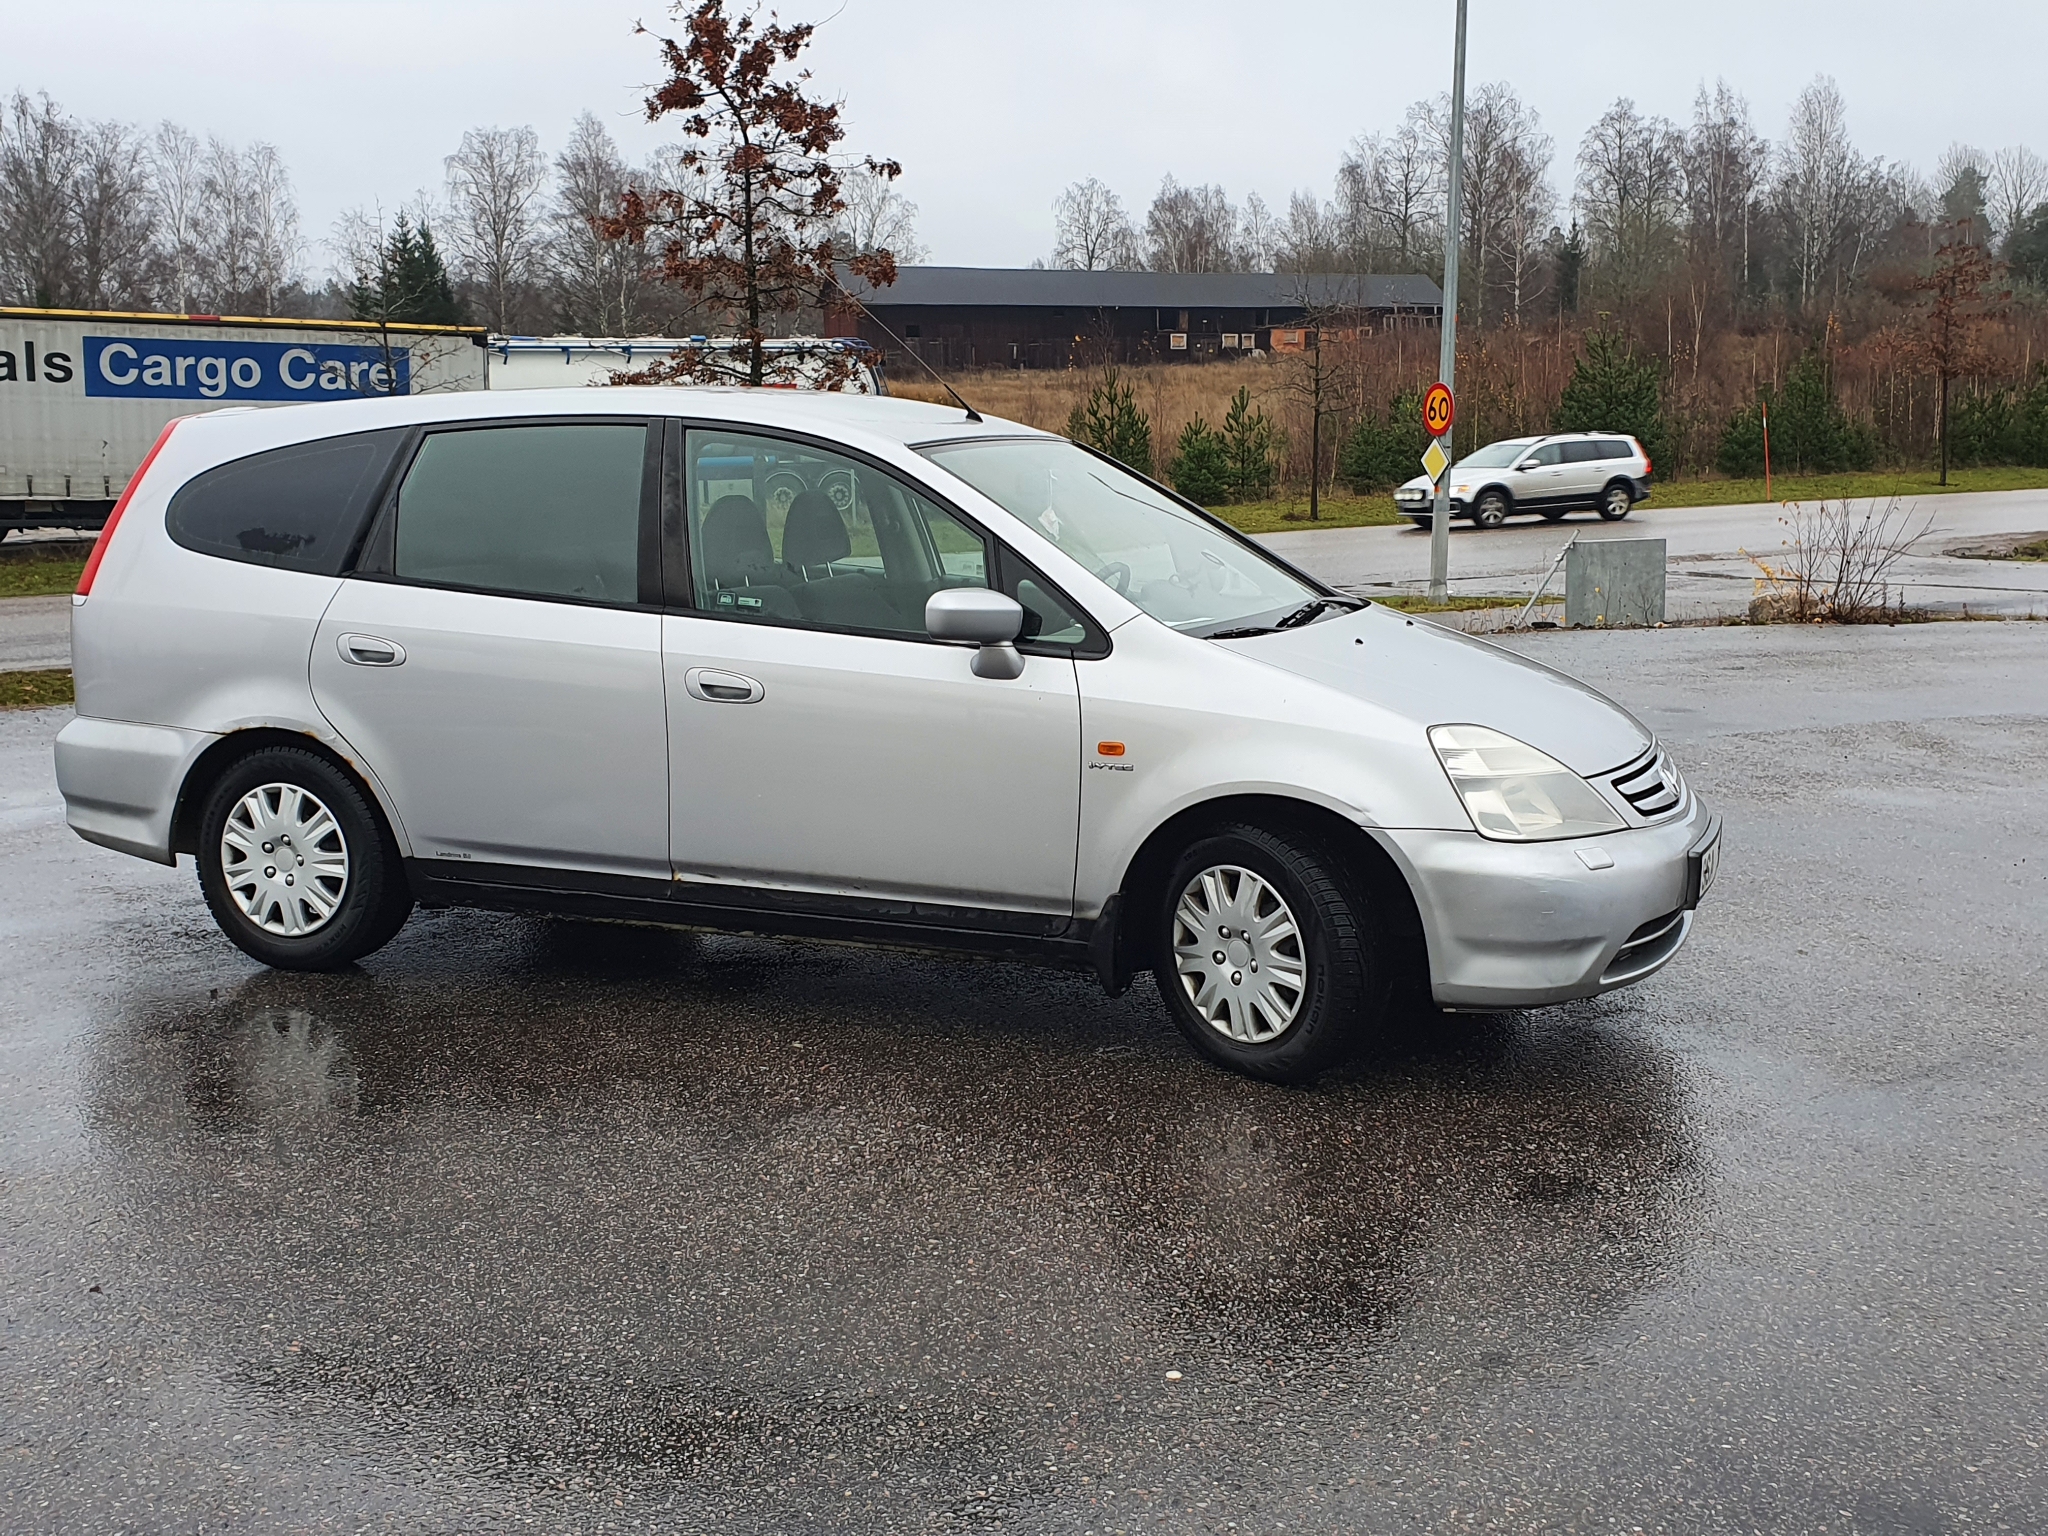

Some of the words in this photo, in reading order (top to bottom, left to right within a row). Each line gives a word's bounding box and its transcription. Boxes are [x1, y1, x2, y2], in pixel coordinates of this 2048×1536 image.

[99, 342, 262, 397] Cargo
[279, 348, 397, 392] Care
[1428, 397, 1449, 421] 60
